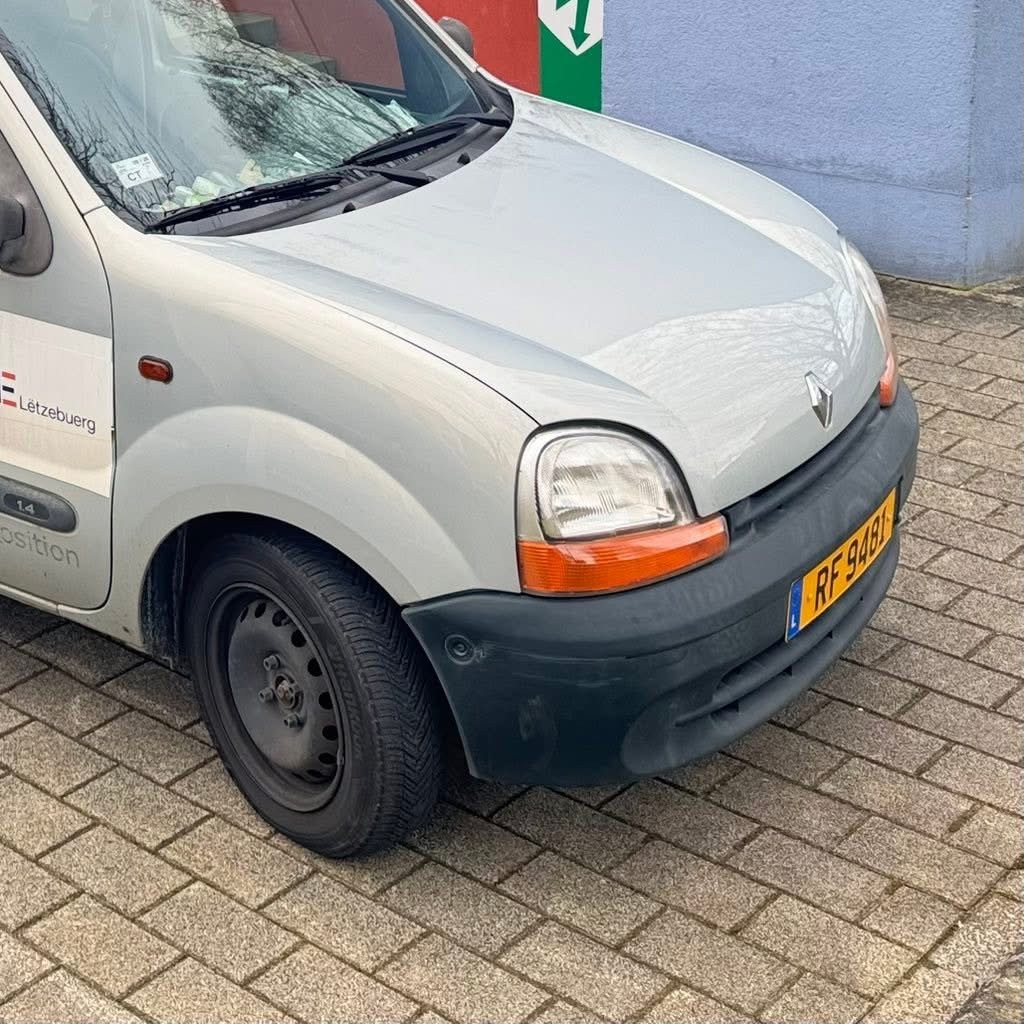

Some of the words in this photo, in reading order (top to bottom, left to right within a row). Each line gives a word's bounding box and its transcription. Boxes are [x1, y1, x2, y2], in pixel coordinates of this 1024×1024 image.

[19, 395, 97, 435] Lëtzebuerg
[16, 500, 35, 515] 1.4
[815, 552, 843, 613] RF
[846, 505, 888, 582] 9481
